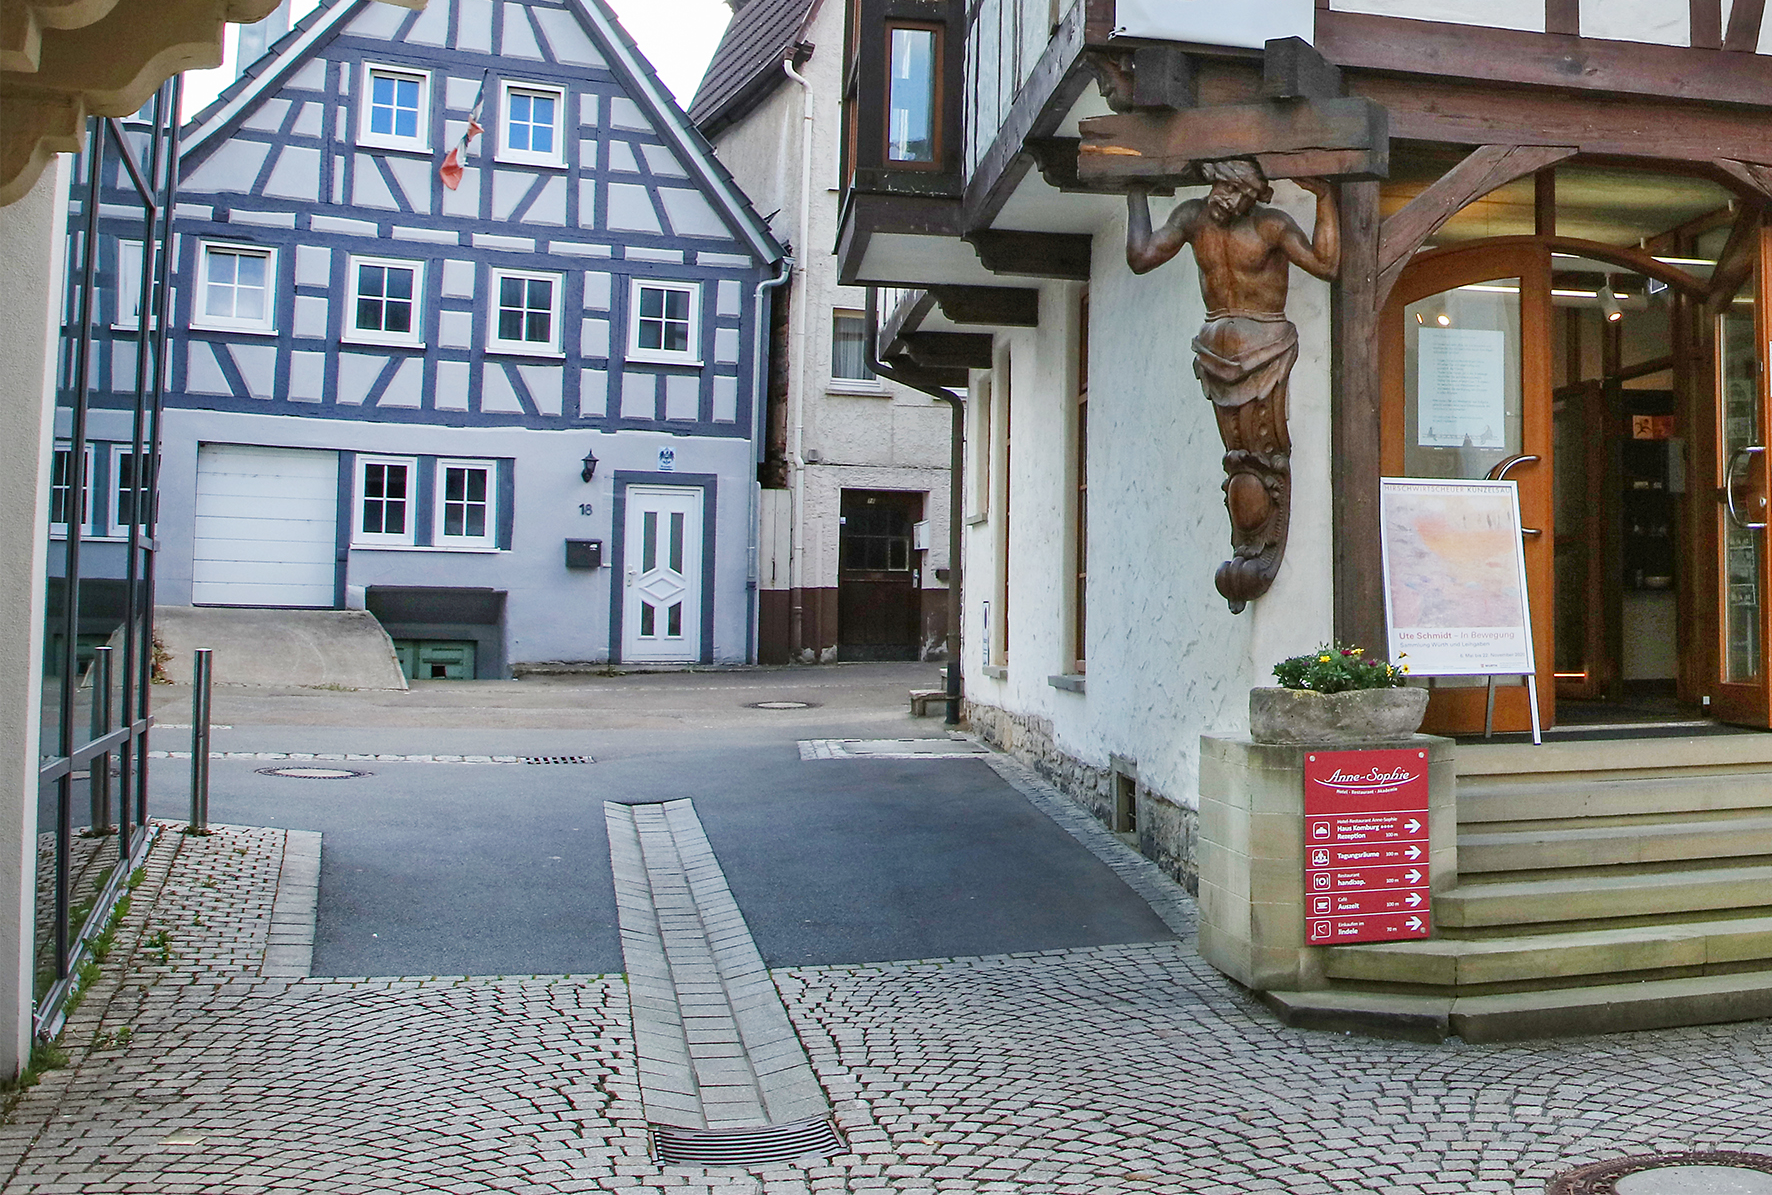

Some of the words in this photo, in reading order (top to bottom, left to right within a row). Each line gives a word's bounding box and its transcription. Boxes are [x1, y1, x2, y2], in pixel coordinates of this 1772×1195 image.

[578, 503, 593, 516] 18
[1399, 632, 1415, 640] Ute
[1416, 632, 1452, 640] Schmidt
[1471, 631, 1515, 640] Bewegung
[1323, 767, 1410, 785] Anne-Sophie
